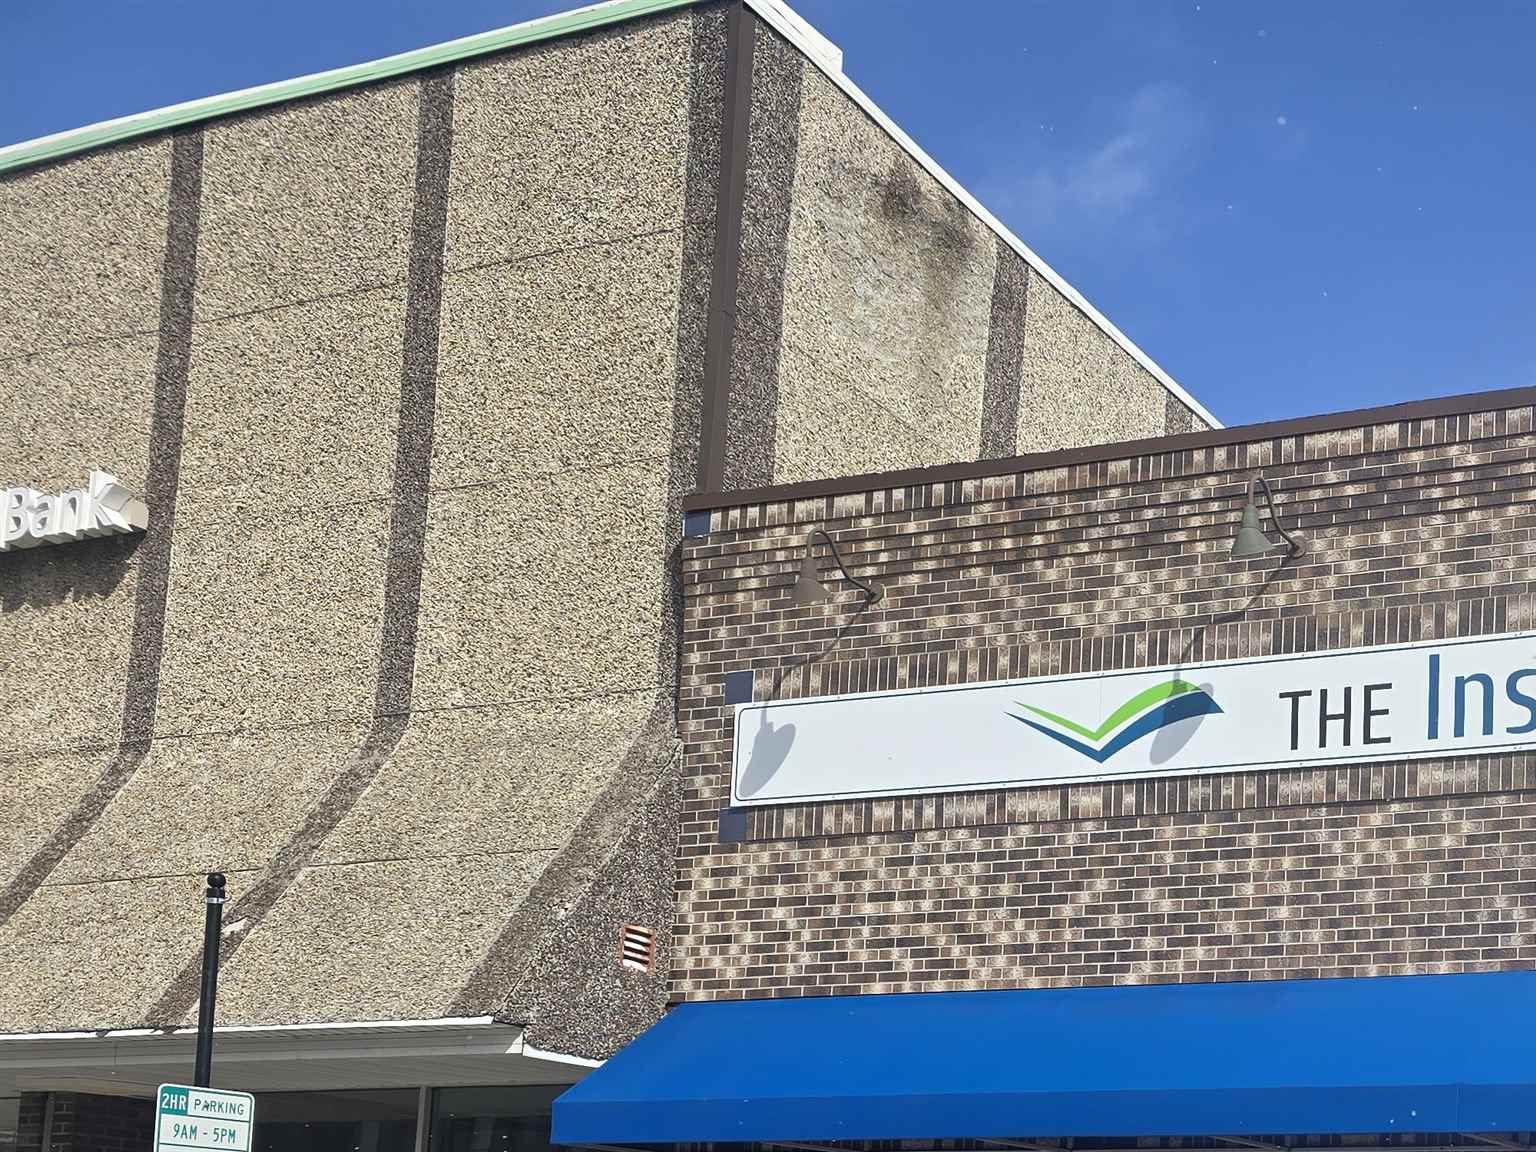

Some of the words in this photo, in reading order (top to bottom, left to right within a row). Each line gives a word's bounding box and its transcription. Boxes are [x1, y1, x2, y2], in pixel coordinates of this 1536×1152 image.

[3, 468, 144, 547] Bank
[1279, 683, 1392, 751] THE
[161, 1093, 187, 1111] 2HR
[194, 1099, 244, 1116] PARKING
[173, 1123, 198, 1140] 9AM
[213, 1127, 236, 1144] 5PM
